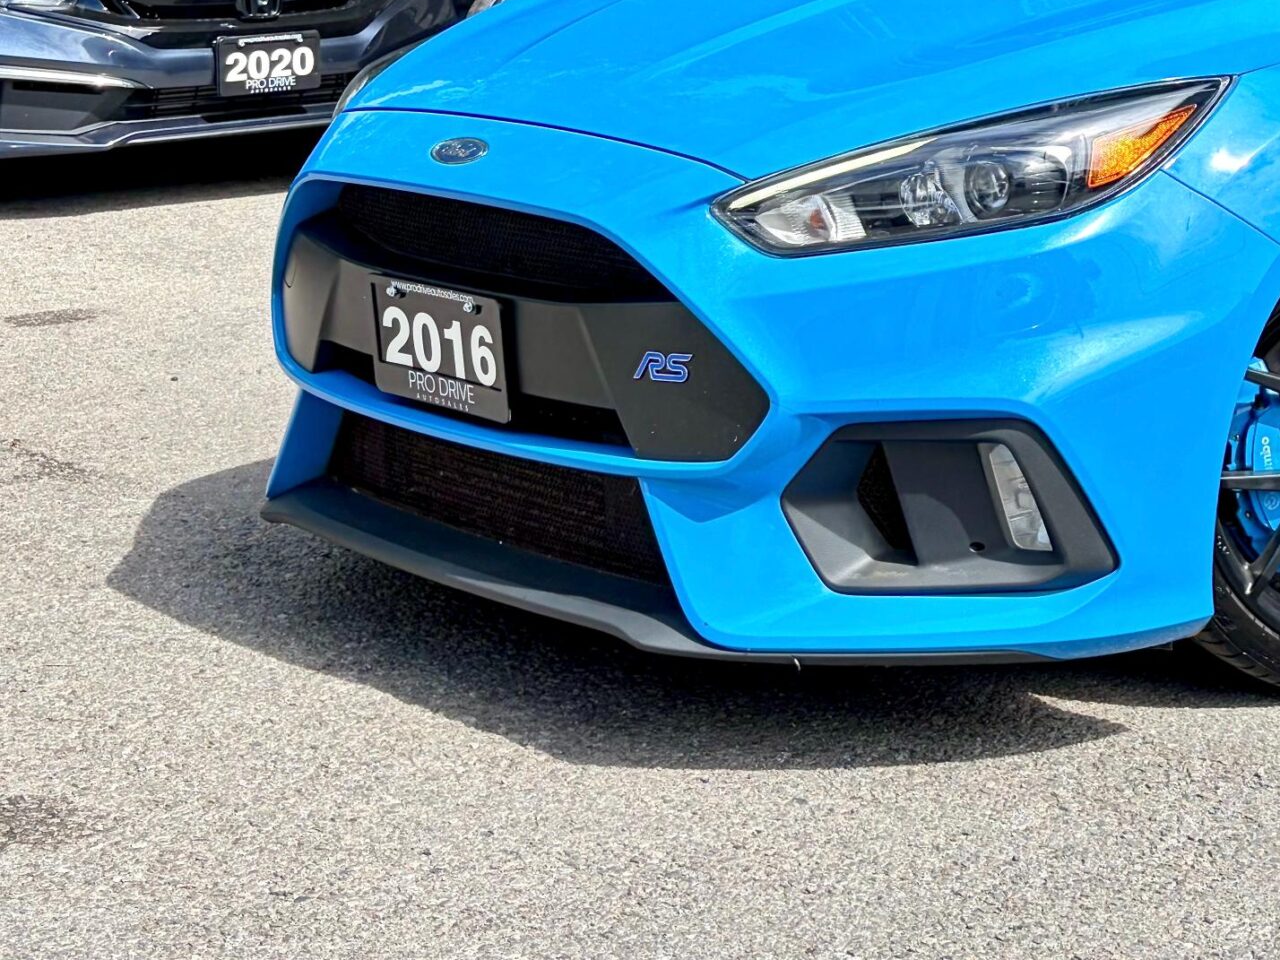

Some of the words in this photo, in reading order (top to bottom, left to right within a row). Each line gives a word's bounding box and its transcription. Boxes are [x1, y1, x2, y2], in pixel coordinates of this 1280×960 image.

[225, 46, 315, 82] 2020
[246, 78, 267, 90] PRO
[268, 75, 296, 88] DRIVE
[382, 306, 497, 387] 2016
[633, 351, 693, 383] RS
[408, 370, 436, 394] PRO
[438, 377, 475, 405] DRIVE
